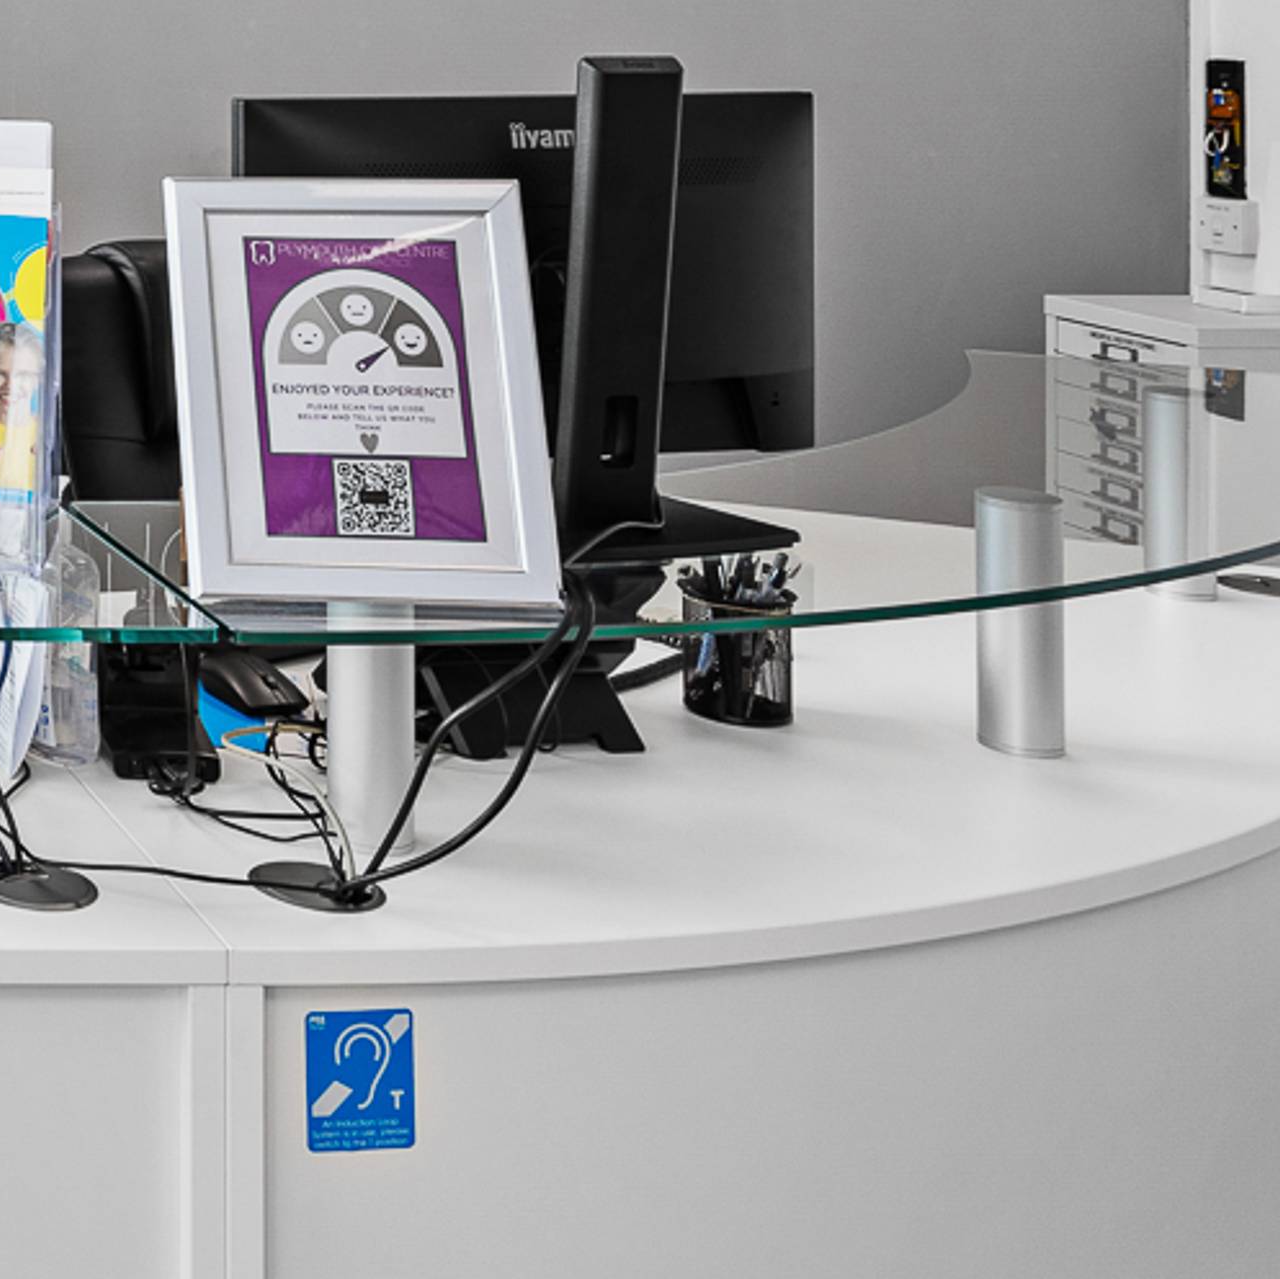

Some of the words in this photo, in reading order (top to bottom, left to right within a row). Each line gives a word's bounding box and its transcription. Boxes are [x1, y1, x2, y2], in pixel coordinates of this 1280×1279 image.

[509, 122, 575, 149] iiyam
[272, 383, 330, 395] ENJOYED
[332, 384, 369, 397] YOUR
[373, 385, 455, 399] EXPERIENCE?
[389, 1088, 405, 1110] T
